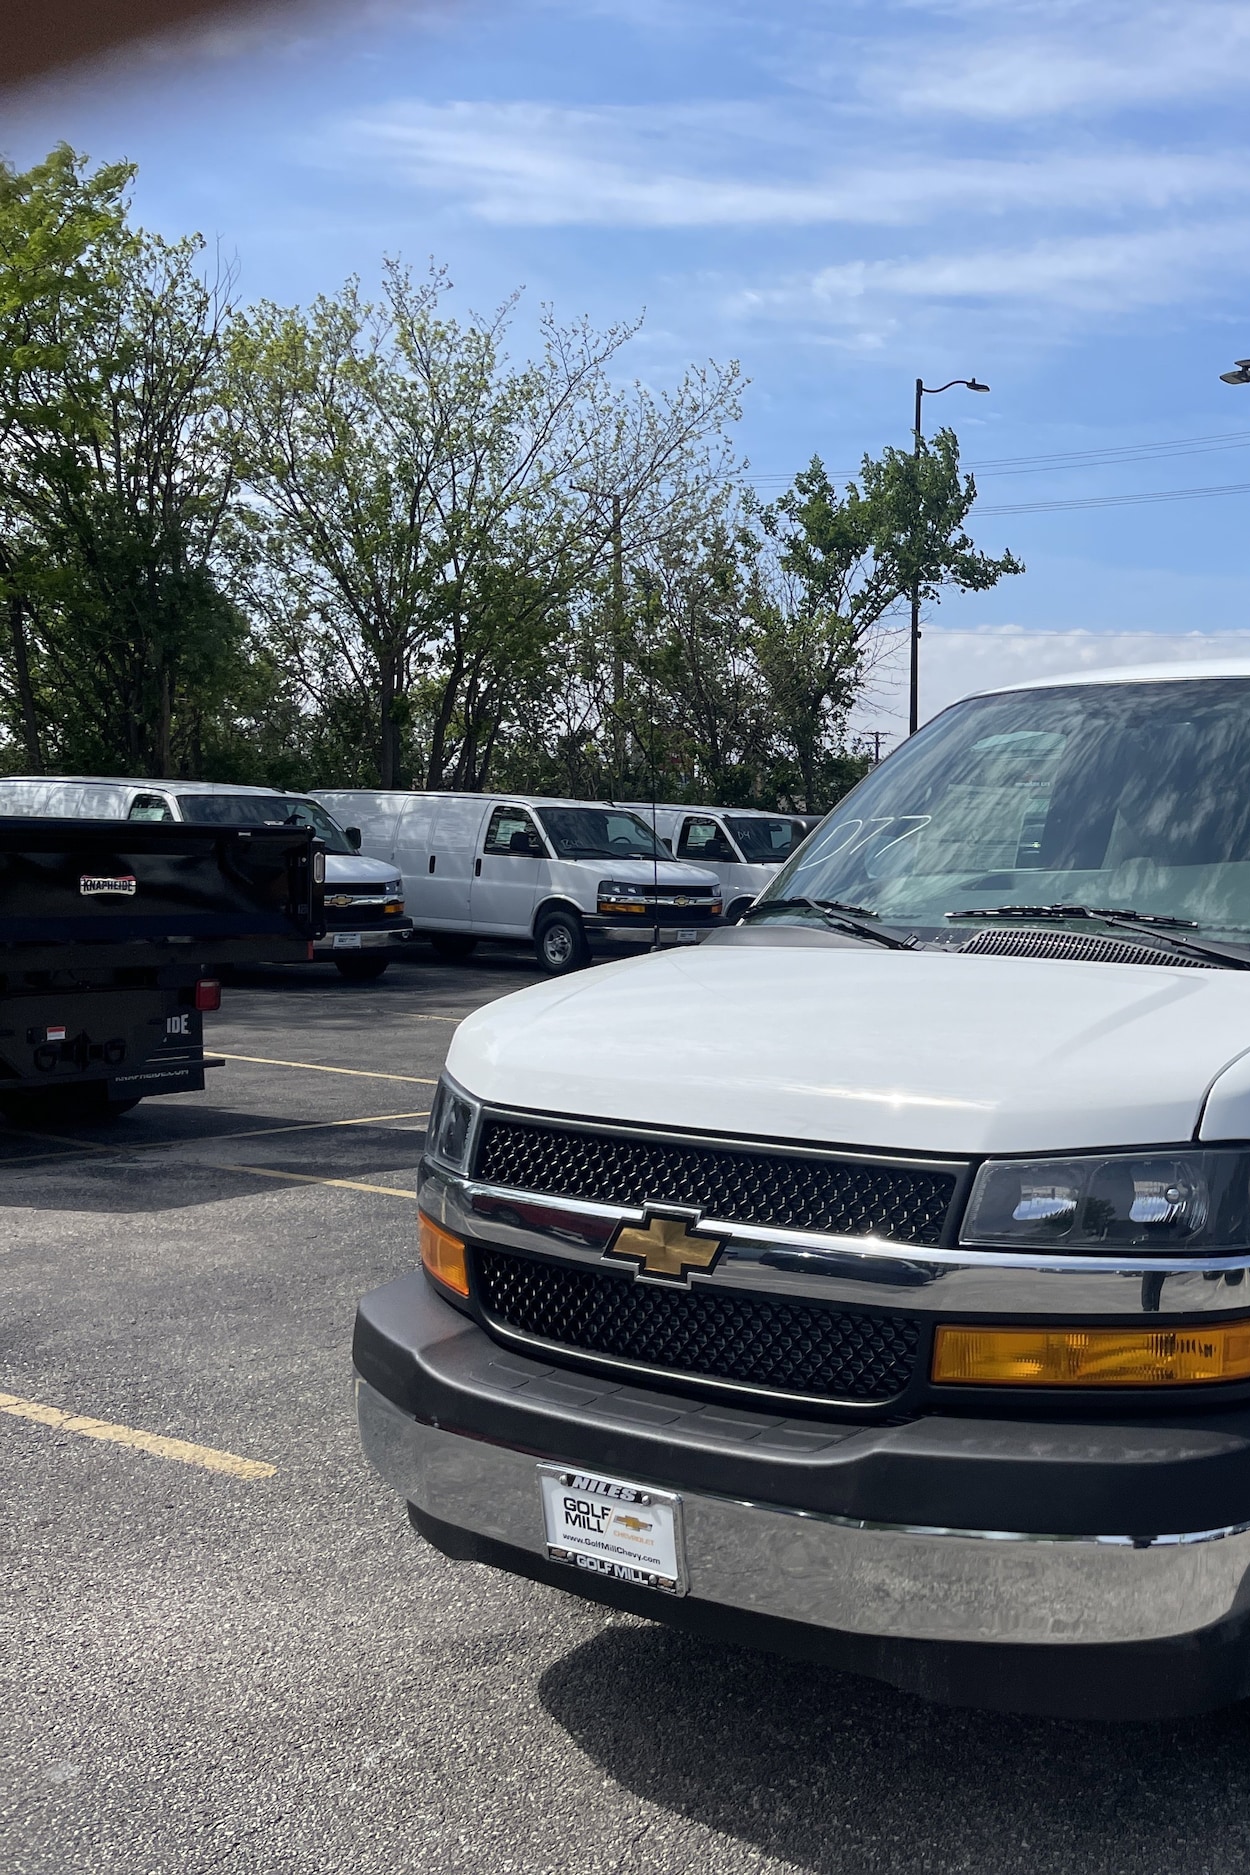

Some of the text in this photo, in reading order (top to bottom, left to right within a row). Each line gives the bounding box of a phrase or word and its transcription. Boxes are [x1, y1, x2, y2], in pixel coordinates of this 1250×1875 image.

[82, 879, 134, 892] KNAPHEIDE
[572, 1475, 638, 1502] NILES
[563, 1497, 611, 1520] GOLF
[565, 1511, 604, 1534] MILL
[562, 1532, 661, 1565] www.GolfMillChevy.com
[613, 1530, 654, 1546] CHEVROLET
[576, 1554, 613, 1573] GOLF
[614, 1565, 649, 1585] MILL
